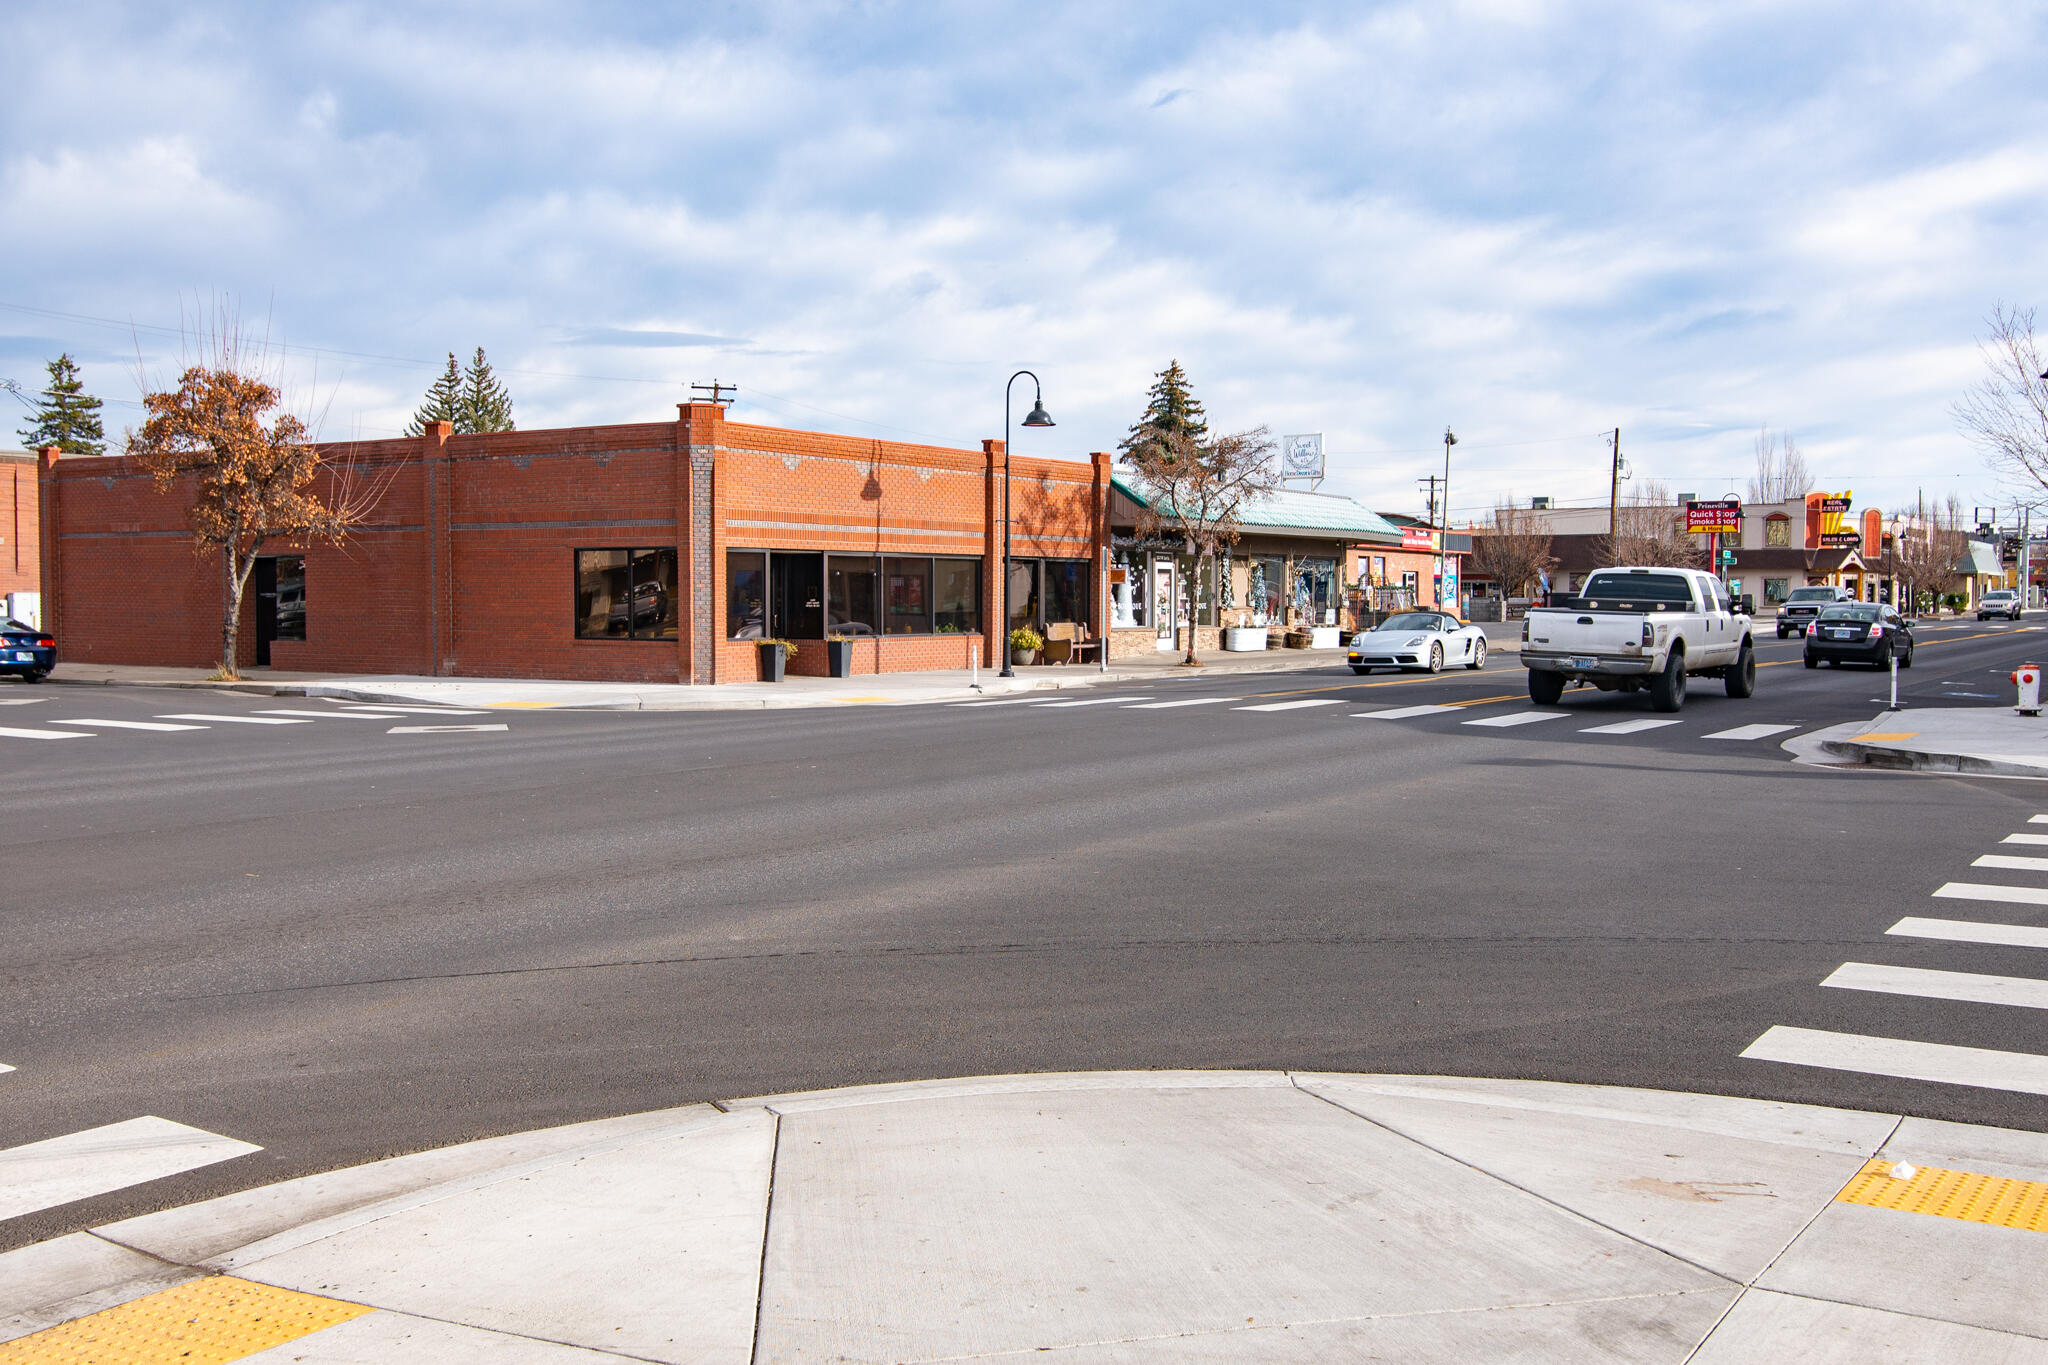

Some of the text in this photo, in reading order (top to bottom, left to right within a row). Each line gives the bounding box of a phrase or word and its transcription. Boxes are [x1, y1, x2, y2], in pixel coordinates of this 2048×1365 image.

[1296, 440, 1311, 449] Sweet
[1293, 449, 1314, 458] Willow
[1690, 510, 1714, 518] Quick
[1117, 602, 1142, 610] BOUQUE
[1185, 602, 1207, 610] BQUE
